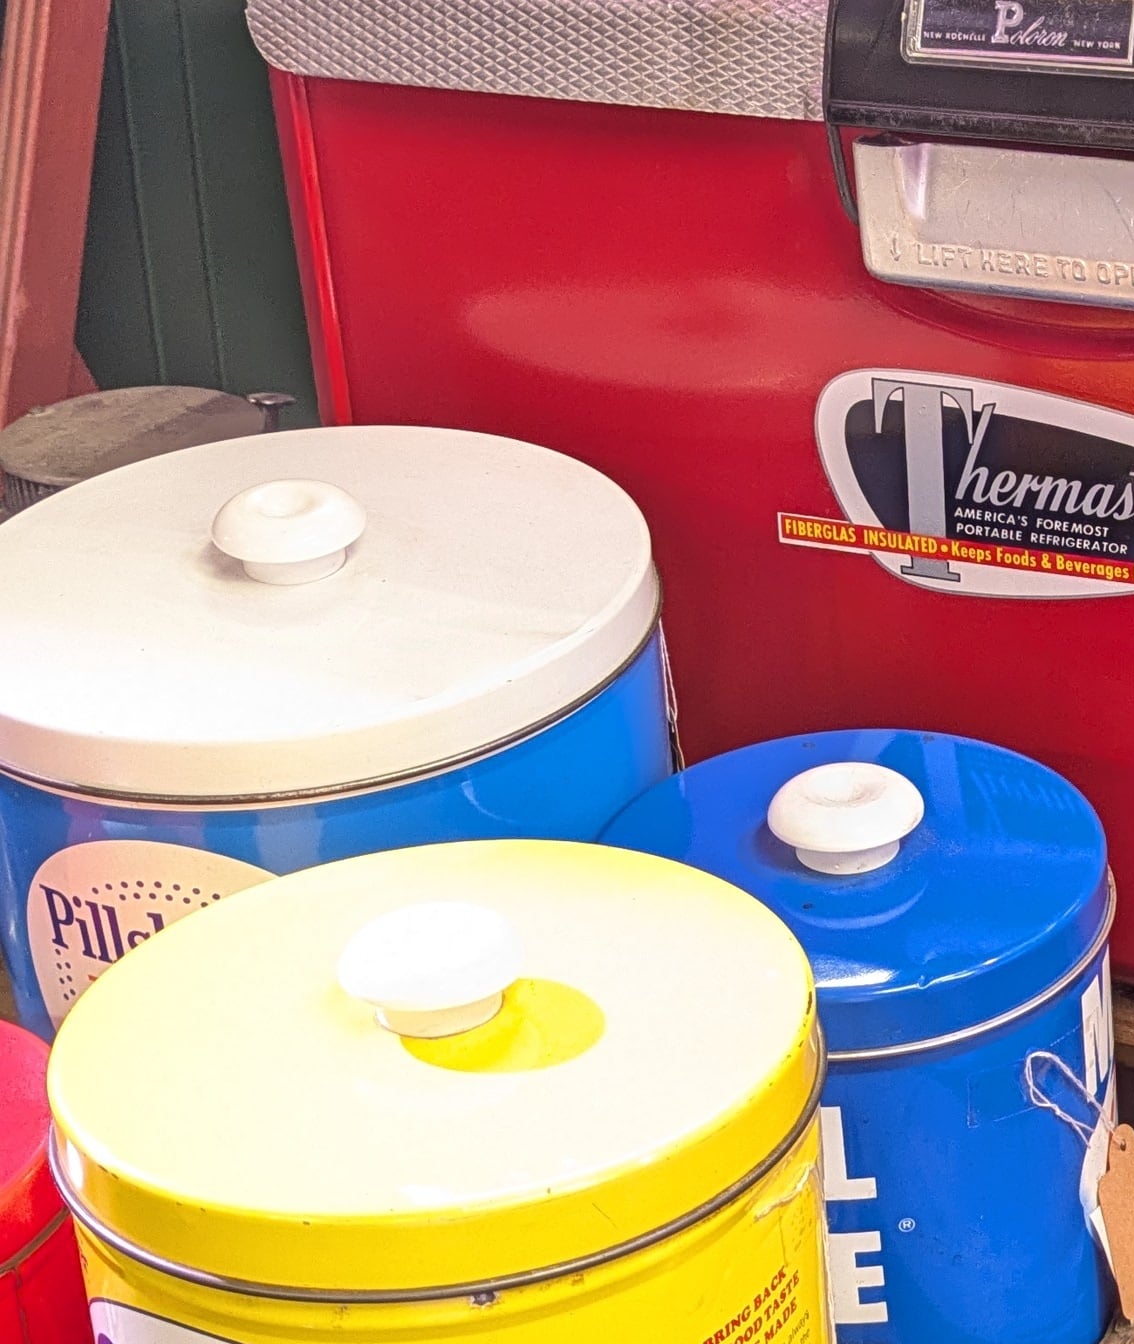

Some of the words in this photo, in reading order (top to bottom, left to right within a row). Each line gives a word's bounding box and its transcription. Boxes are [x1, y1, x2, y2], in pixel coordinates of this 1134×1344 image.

[990, 0, 1068, 48] Poloron
[914, 242, 972, 270] LIFT
[980, 249, 1049, 278] HERE
[1057, 258, 1086, 282] TO
[954, 506, 1029, 527] AMERICA'S
[1036, 517, 1109, 538] FOREMOST
[956, 522, 1022, 542] PORTABLE
[1030, 532, 1128, 555] REFRIGERATOR
[785, 518, 857, 544] FIBERGLAS
[863, 531, 938, 554] INSULATED
[951, 541, 992, 562] Keeps
[996, 546, 1037, 568] Foods
[1041, 551, 1052, 569] &
[1056, 554, 1130, 582] Beverages
[753, 1264, 787, 1312] BACK
[764, 1269, 800, 1322] TASTE
